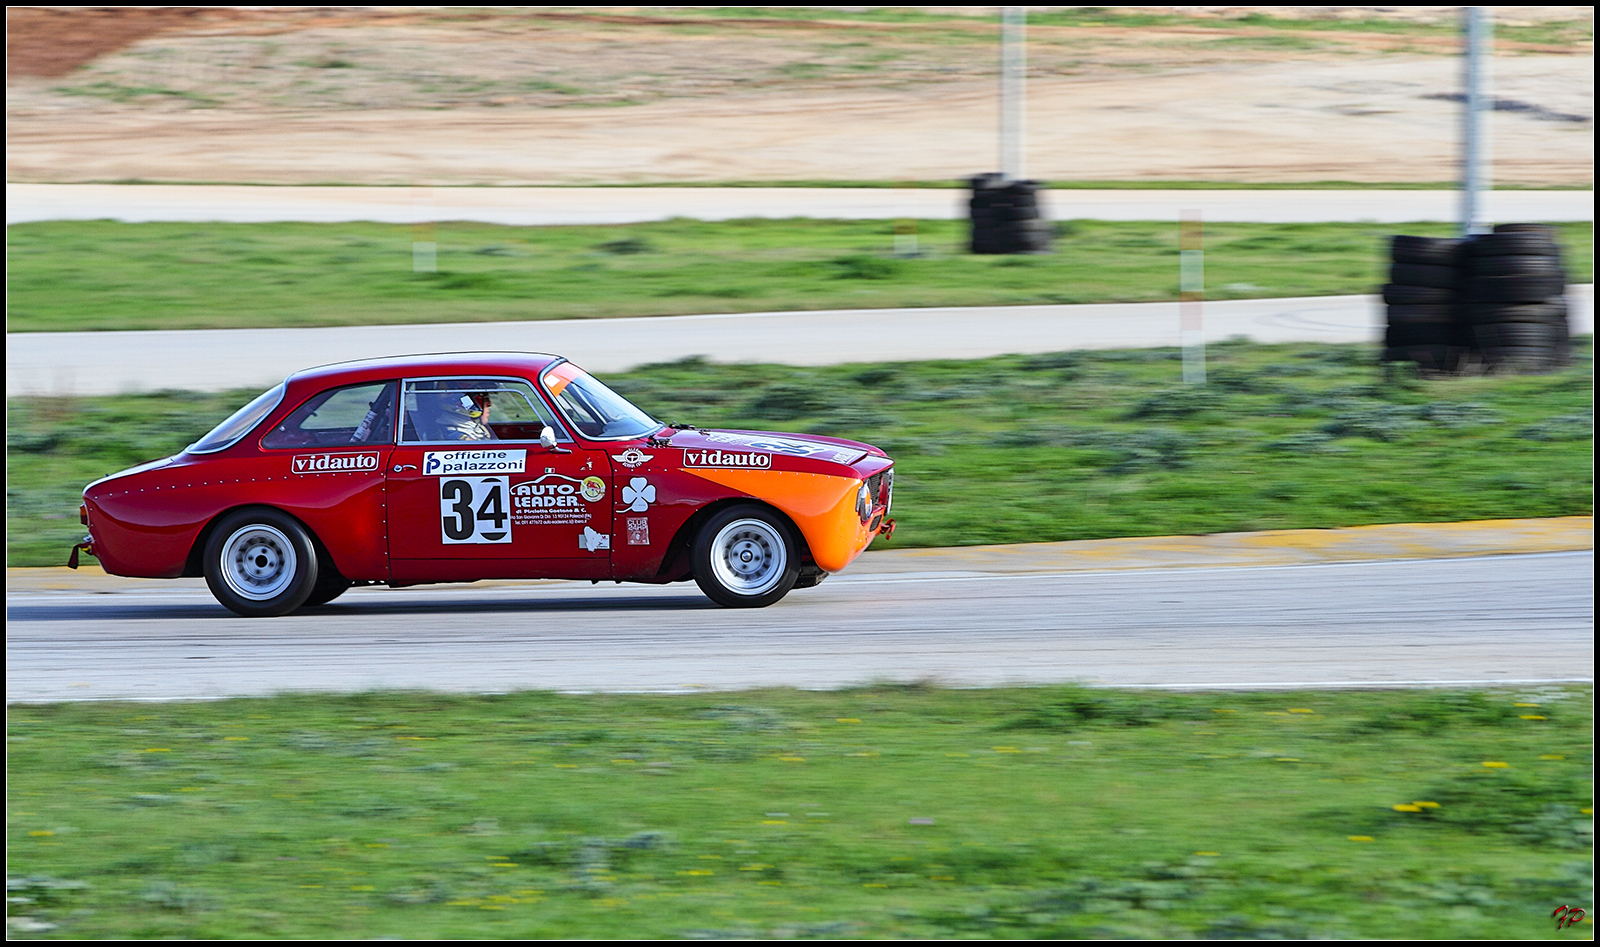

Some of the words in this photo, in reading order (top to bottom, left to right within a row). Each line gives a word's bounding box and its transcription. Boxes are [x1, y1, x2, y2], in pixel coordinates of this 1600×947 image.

[443, 451, 507, 460] officine
[687, 449, 769, 466] vidauto
[295, 454, 377, 471] vidauto
[443, 460, 523, 473] palazzoni
[517, 484, 575, 496] AUTO
[514, 495, 578, 508] LEADER
[442, 479, 508, 541] 34
